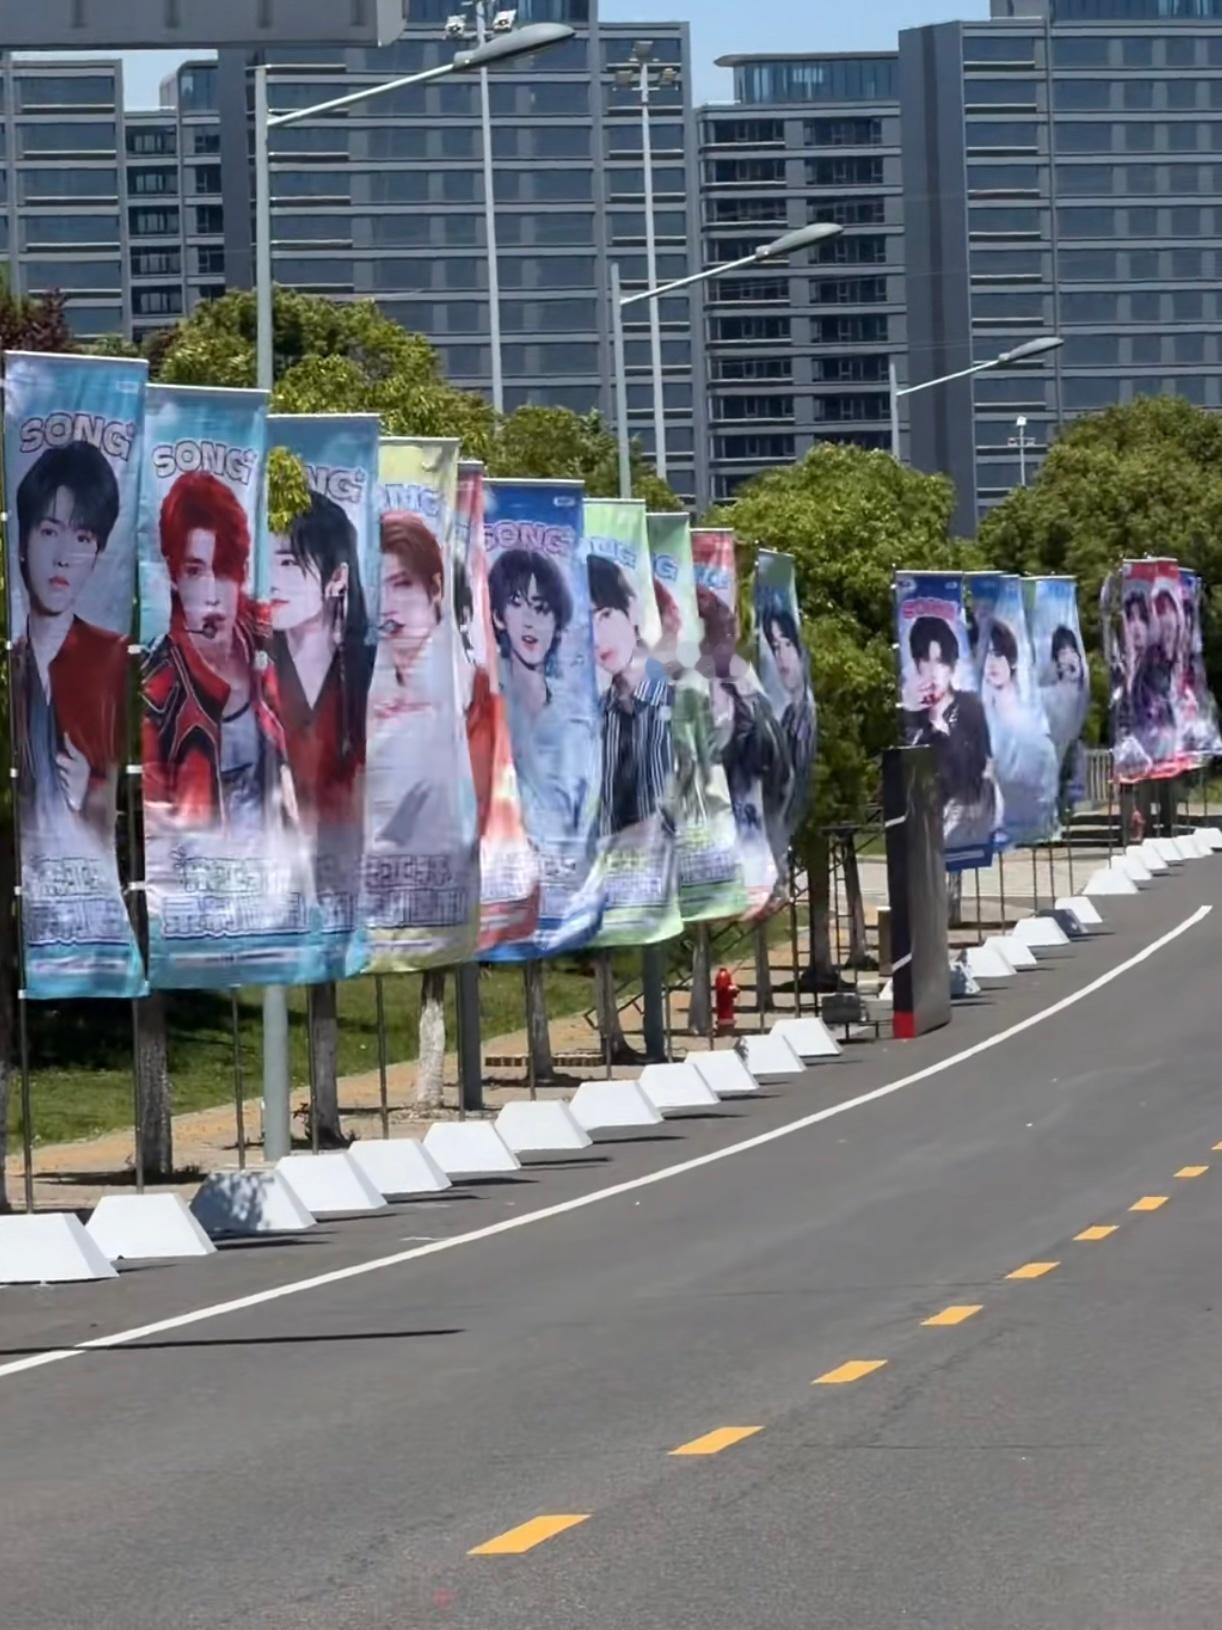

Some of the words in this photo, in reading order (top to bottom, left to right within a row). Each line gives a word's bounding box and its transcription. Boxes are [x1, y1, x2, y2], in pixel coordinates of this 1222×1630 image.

[20, 411, 135, 462] SONG
[152, 440, 255, 485] SONG
[303, 465, 363, 503] NG
